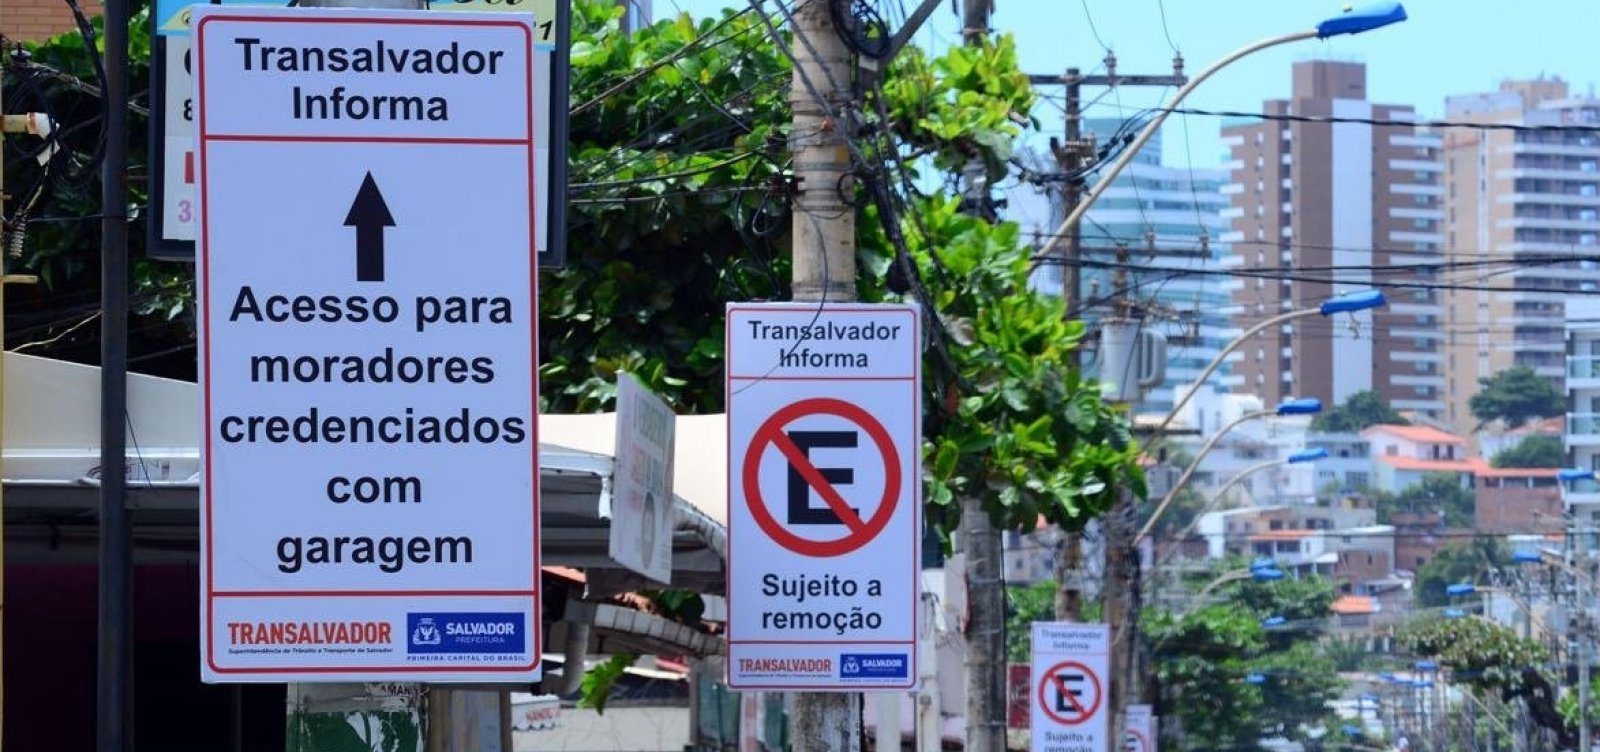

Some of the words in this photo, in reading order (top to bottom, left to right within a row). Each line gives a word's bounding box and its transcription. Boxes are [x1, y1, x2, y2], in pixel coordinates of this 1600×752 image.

[235, 38, 503, 75] Transalvador
[293, 87, 448, 121] Informa
[230, 286, 399, 323] Acesso
[416, 297, 513, 332] para
[748, 320, 900, 340] Transalvador
[251, 348, 495, 384] moradores
[779, 349, 868, 367] Informa
[220, 408, 526, 444] credenciados
[326, 476, 422, 504] com
[788, 431, 859, 524] E
[277, 536, 473, 573] garagem
[763, 574, 858, 602] Sujeito
[867, 580, 882, 597] a
[228, 621, 391, 645] TRANSALVADOR
[445, 622, 515, 635] SALVADOR
[763, 607, 882, 635] remoção
[738, 659, 832, 672] TRANSALVADOR
[1056, 674, 1084, 712] E
